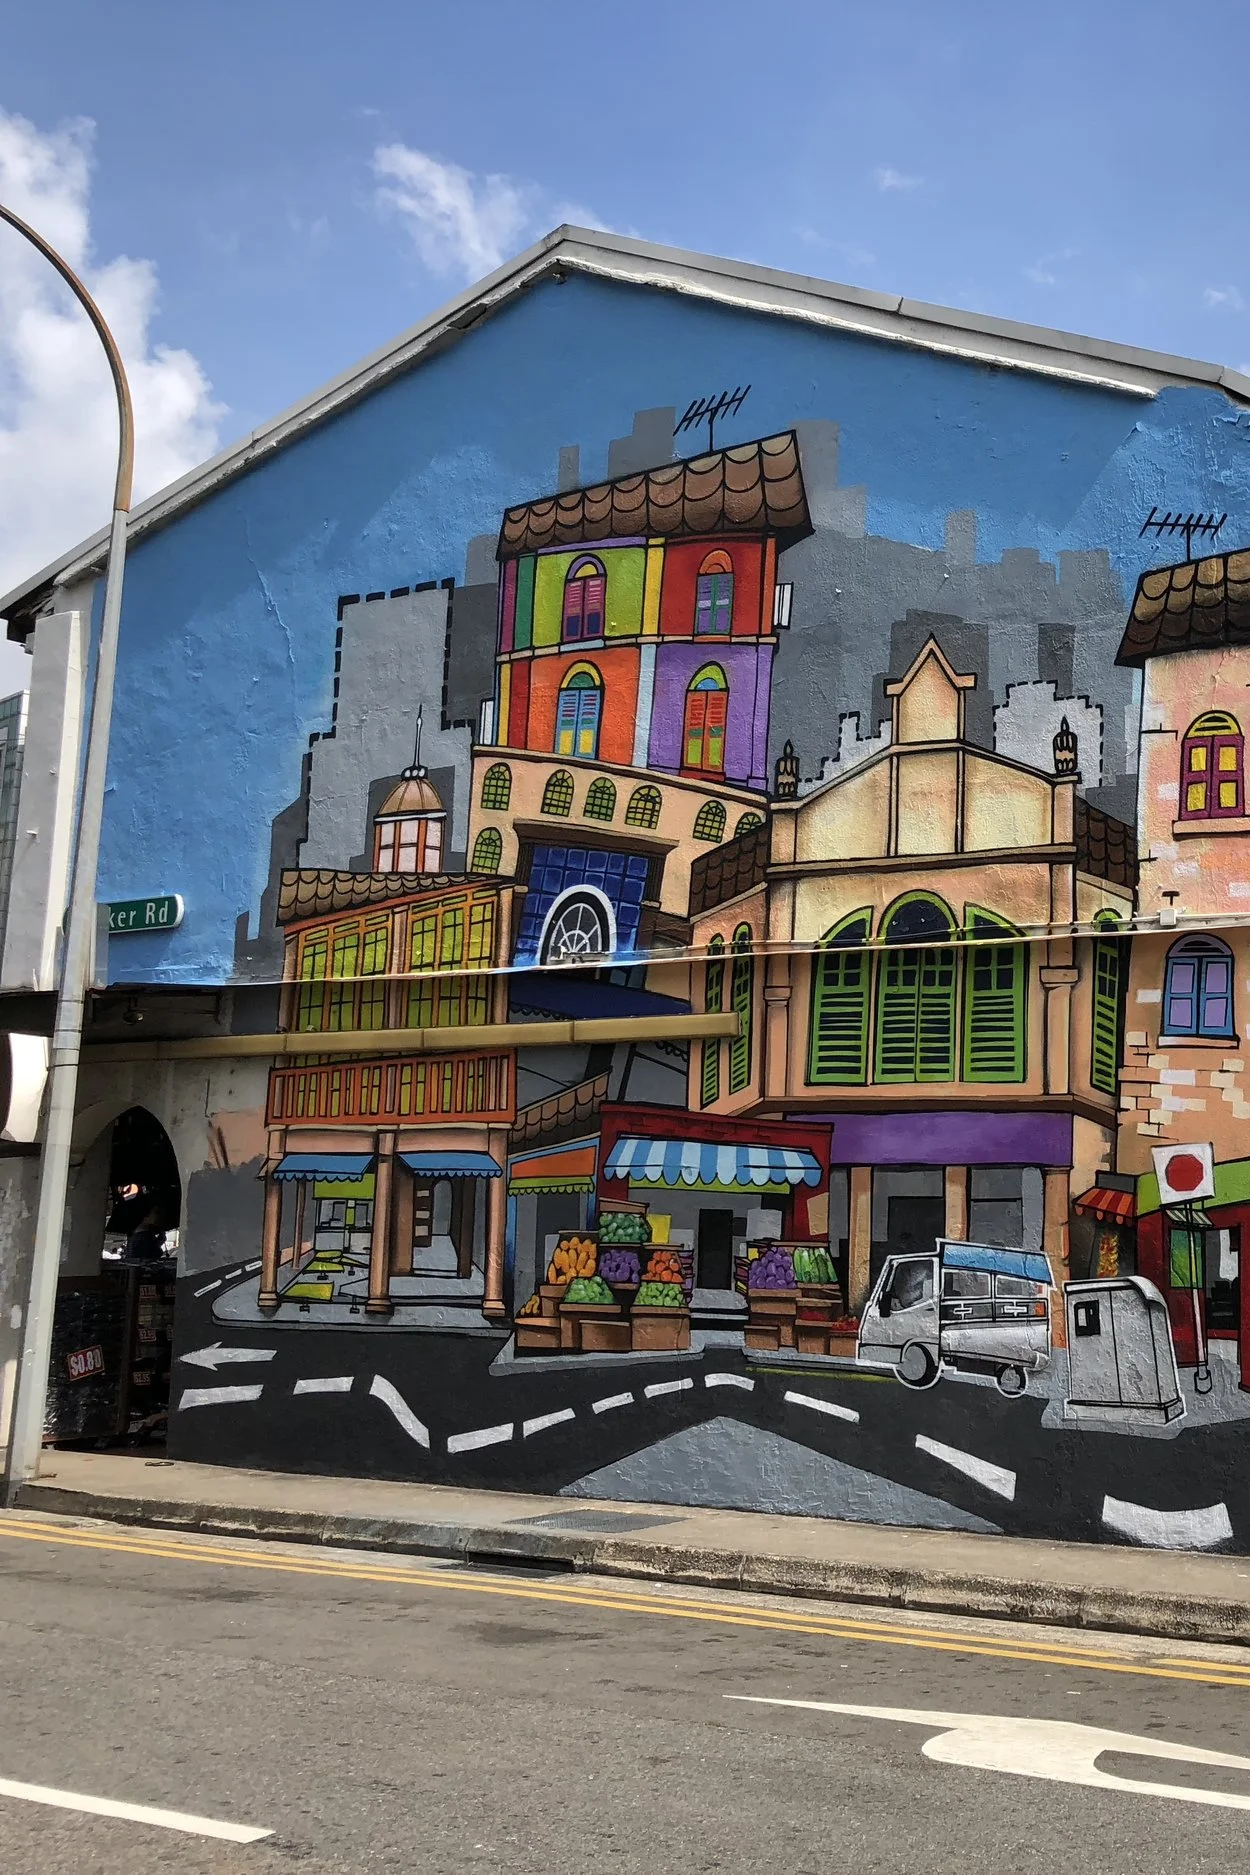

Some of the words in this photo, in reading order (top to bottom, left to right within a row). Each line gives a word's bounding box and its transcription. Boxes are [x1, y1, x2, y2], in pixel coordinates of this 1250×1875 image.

[109, 906, 137, 928] ker
[145, 901, 168, 925] Rd
[70, 1349, 102, 1377] $0.80
